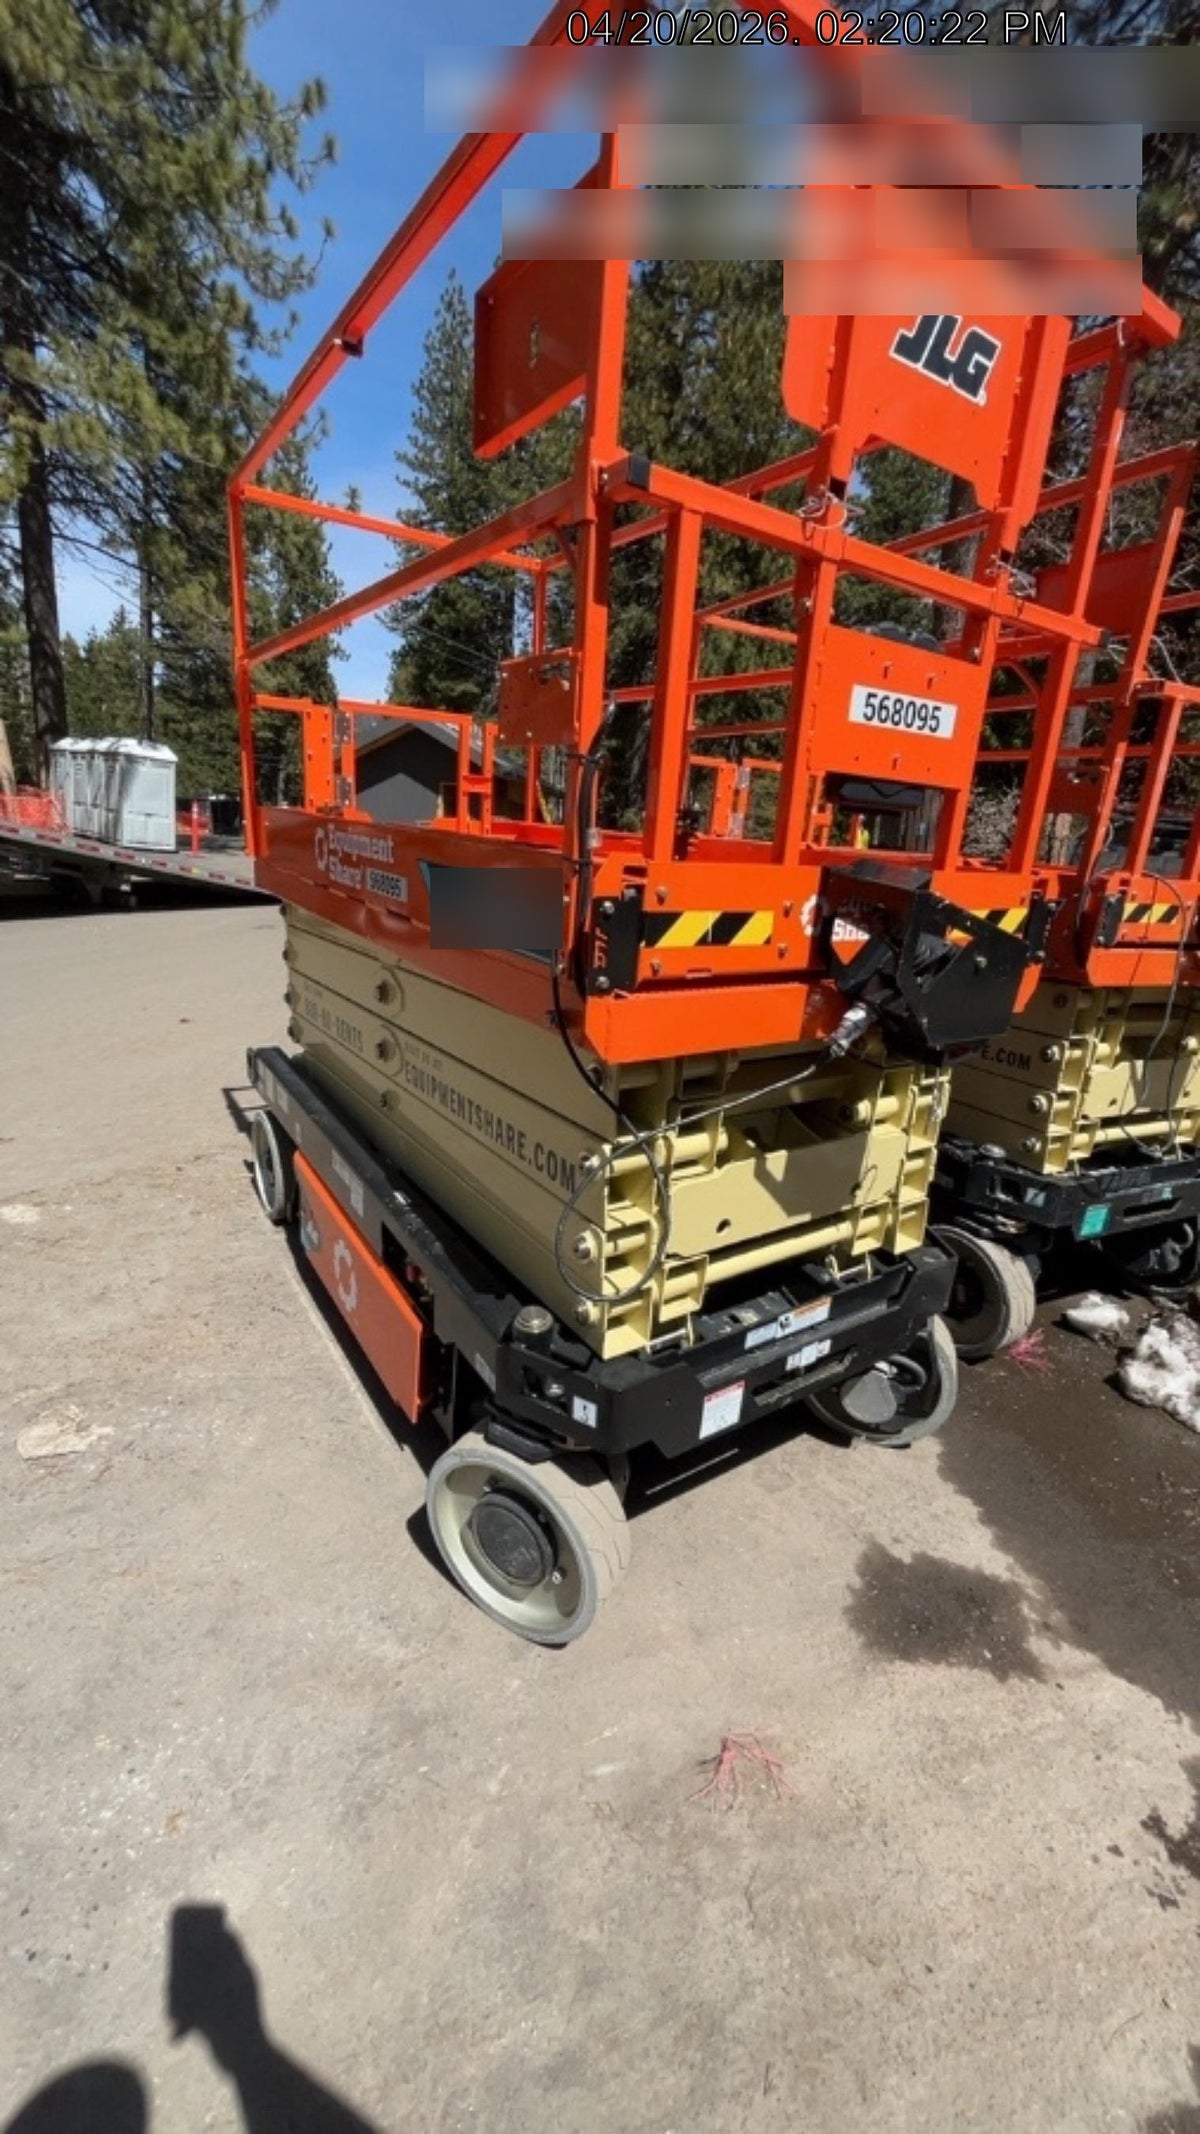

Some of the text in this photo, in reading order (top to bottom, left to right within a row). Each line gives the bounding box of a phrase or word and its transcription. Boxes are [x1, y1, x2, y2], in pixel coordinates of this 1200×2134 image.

[889, 315, 1001, 406] JLG
[862, 691, 942, 733] 568095
[404, 1060, 576, 1193] EQUIPMENTSHARE.COM
